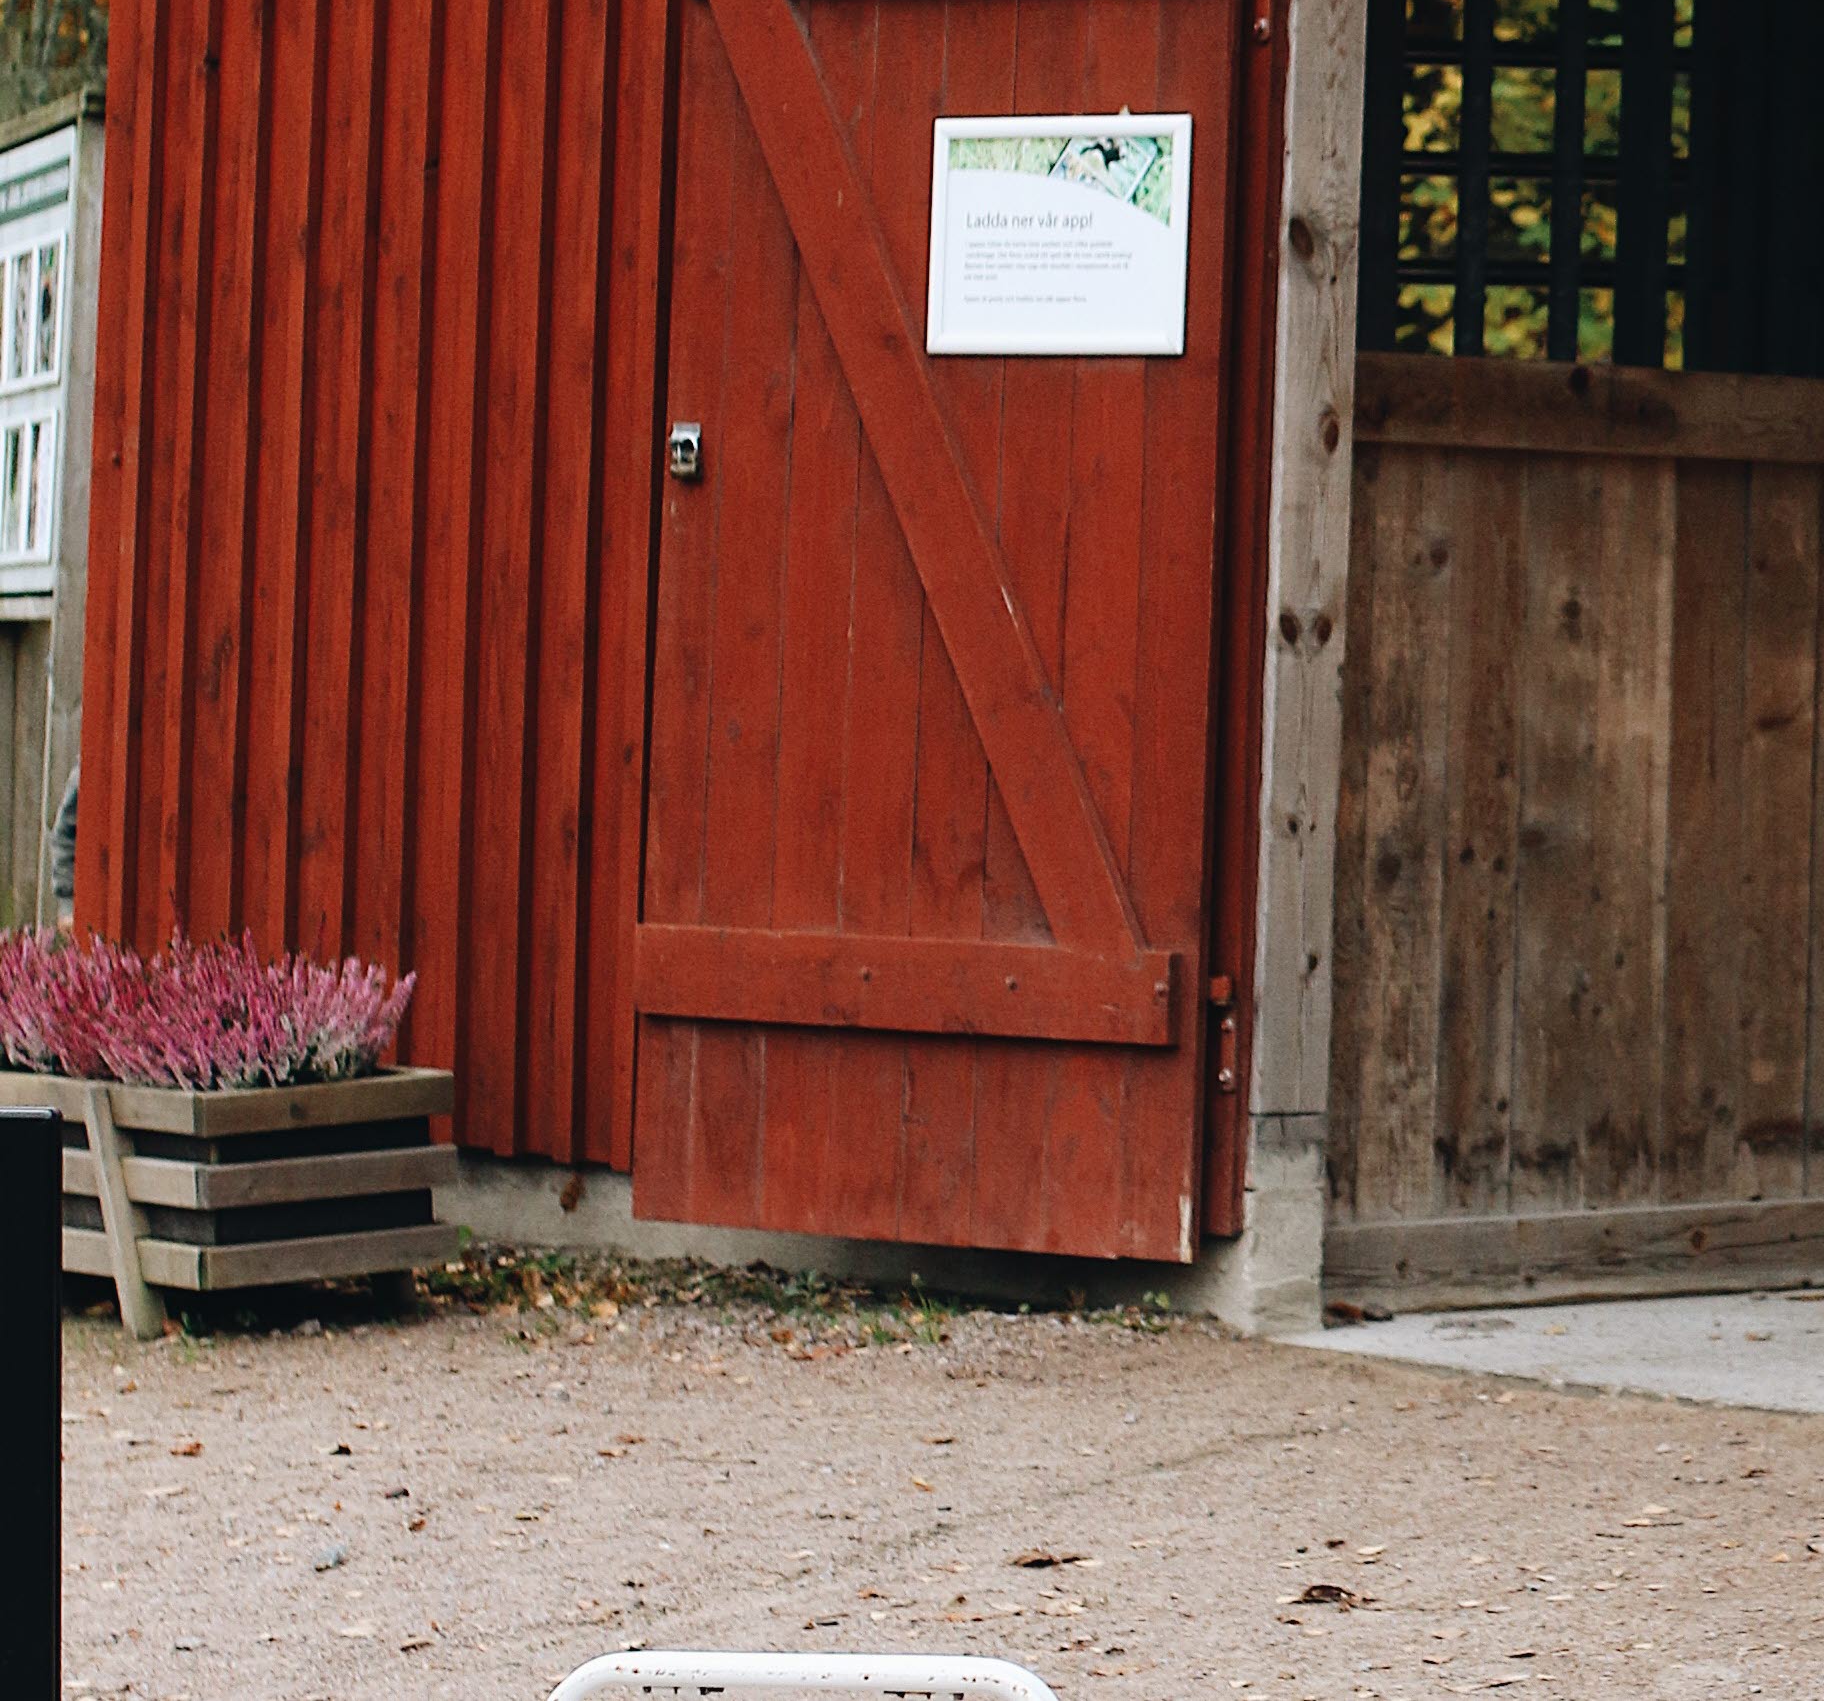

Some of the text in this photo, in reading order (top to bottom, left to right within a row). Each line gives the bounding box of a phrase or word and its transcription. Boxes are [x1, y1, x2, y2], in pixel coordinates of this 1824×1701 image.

[966, 212, 1093, 232] Ladda ner vår app!
